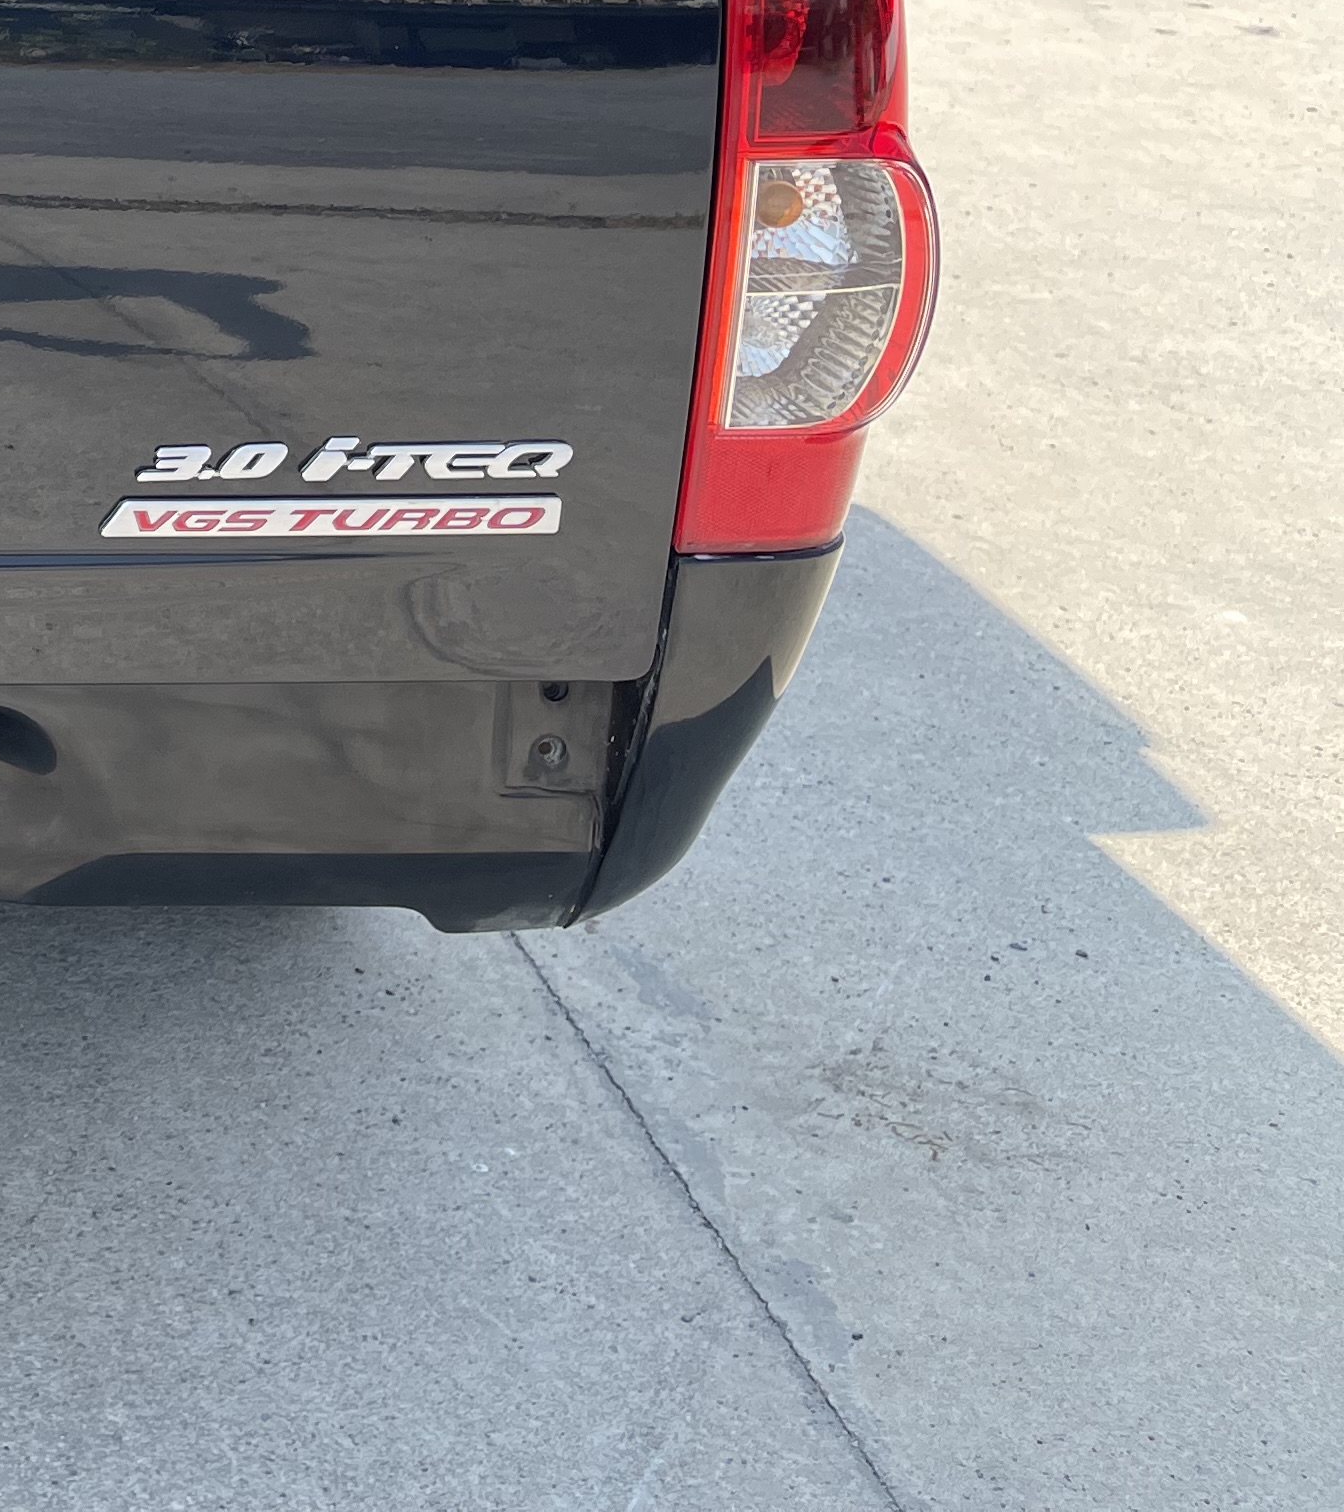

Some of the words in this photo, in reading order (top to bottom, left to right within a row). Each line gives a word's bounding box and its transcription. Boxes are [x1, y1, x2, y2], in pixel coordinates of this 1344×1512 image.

[134, 442, 290, 483] 3.0
[299, 434, 575, 483] i-TEQ
[132, 508, 276, 533] VGS
[288, 506, 547, 532] TURBO
